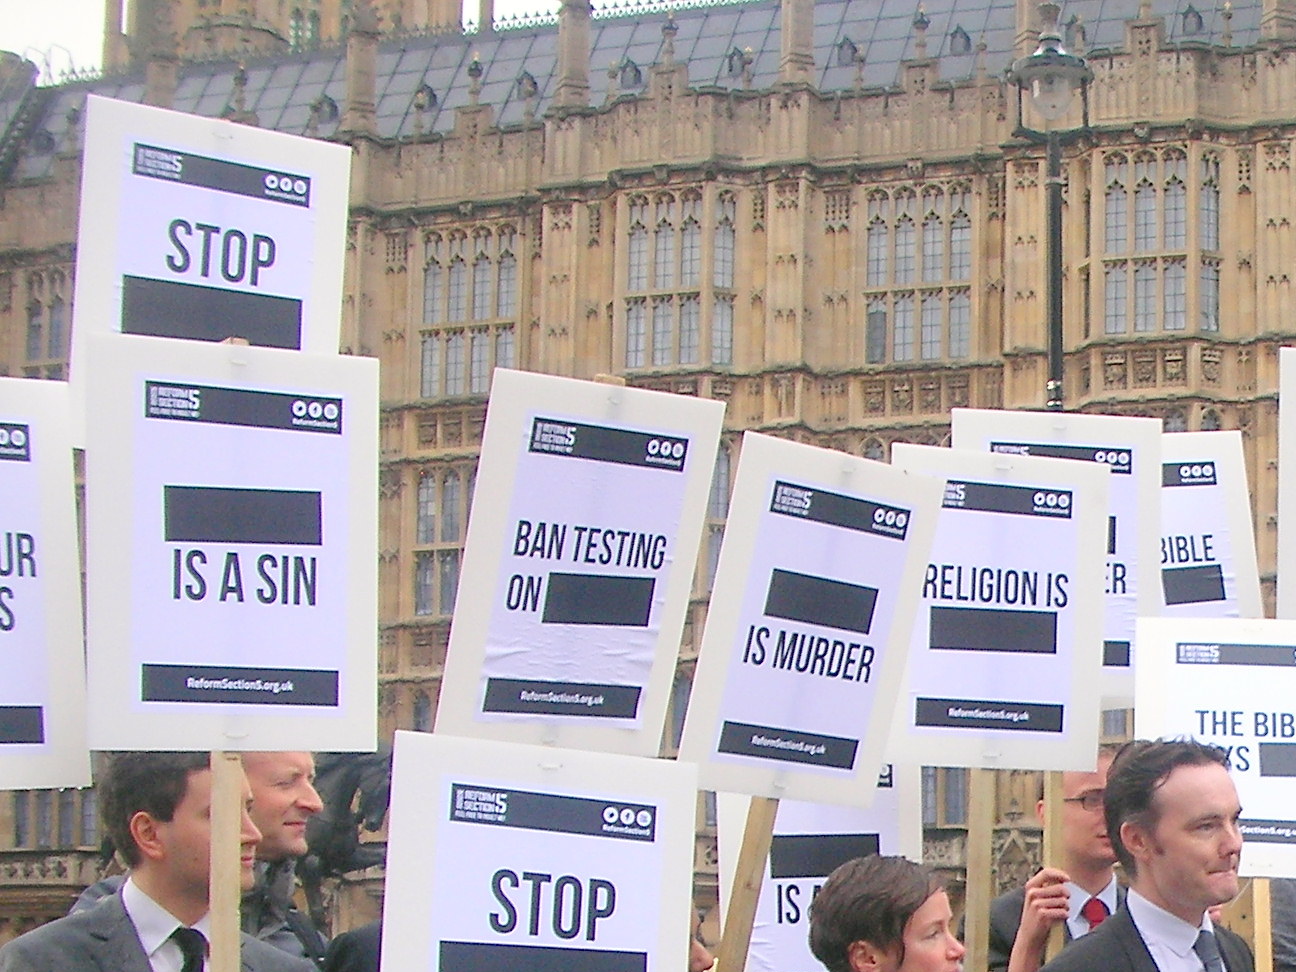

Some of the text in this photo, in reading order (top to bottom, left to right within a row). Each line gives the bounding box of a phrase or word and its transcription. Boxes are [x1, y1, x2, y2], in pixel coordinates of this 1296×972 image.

[167, 219, 275, 286] STOP
[0, 533, 37, 577] UR
[514, 520, 666, 569] BAN TESTING
[174, 549, 316, 606] IS A SIN
[507, 575, 542, 612] ON
[923, 564, 1068, 607] RELIGION IS
[1106, 563, 1126, 594] R
[0, 586, 15, 631] S
[744, 625, 874, 683] IS MURDER
[1195, 710, 1243, 736] THE
[490, 869, 615, 941] STOP
[778, 885, 800, 923] IS
